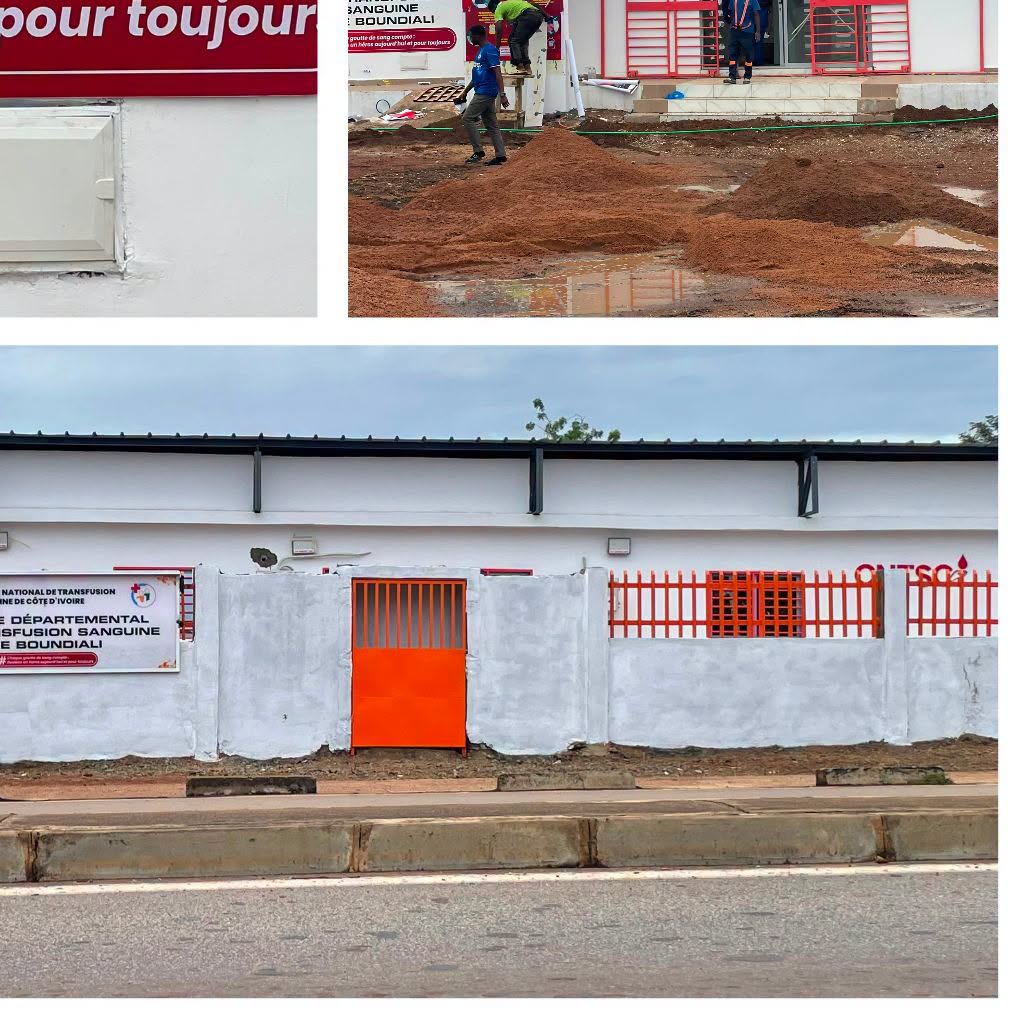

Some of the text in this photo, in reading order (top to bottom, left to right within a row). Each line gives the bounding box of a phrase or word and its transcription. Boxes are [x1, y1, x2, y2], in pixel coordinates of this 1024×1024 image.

[355, 15, 435, 26] BOUNDIALI
[10, 613, 149, 625] DÉPARTEMENTAL
[77, 626, 161, 636] SANGUINE
[16, 639, 103, 649] BOUNDIALI
